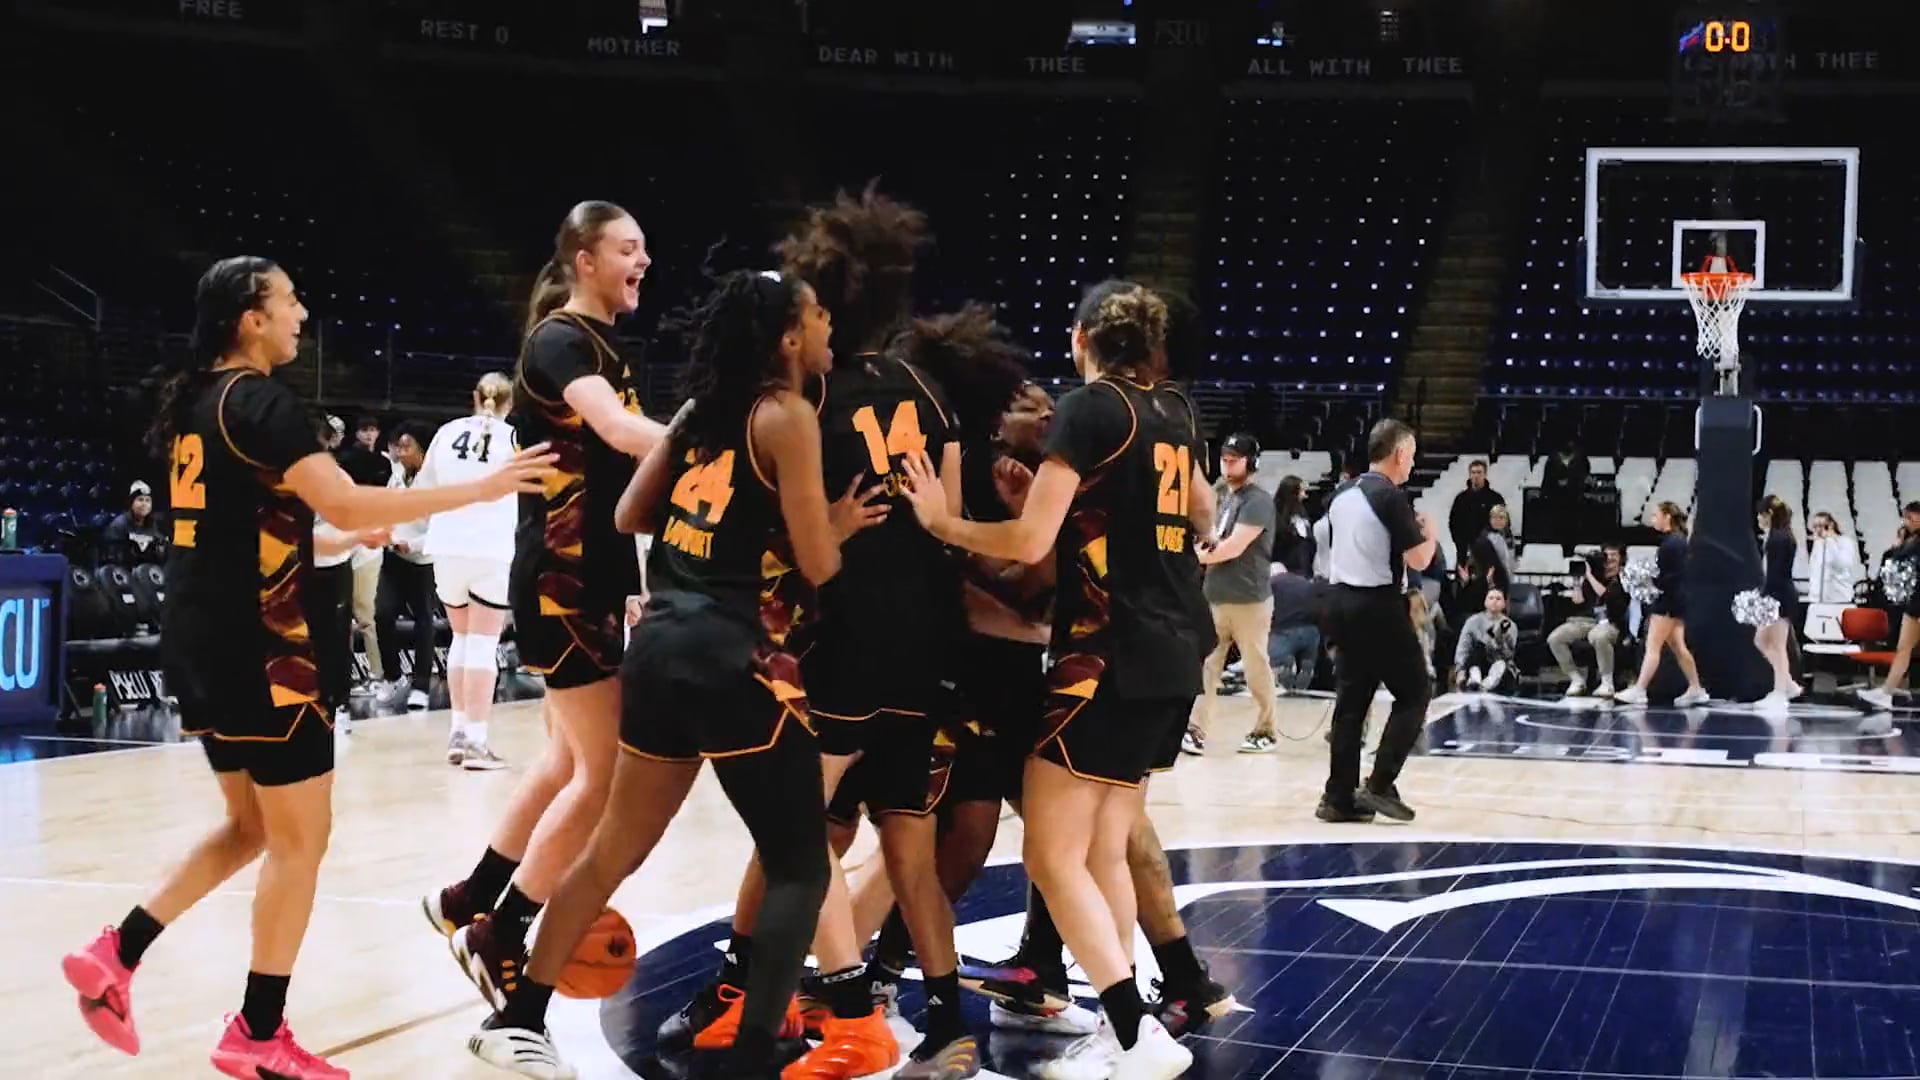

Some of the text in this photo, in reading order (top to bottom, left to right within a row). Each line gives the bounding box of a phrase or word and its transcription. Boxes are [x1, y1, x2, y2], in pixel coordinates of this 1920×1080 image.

[179, 0, 244, 18] FREE
[420, 18, 479, 40] REST
[587, 36, 680, 56] MOTHER
[818, 44, 954, 70] DEAR WITH
[1024, 56, 1087, 73] THEE
[1247, 57, 1464, 76] ALL WITH THEE
[1816, 51, 1880, 69] THEE
[852, 400, 928, 475] 14
[1154, 442, 1190, 516] 21
